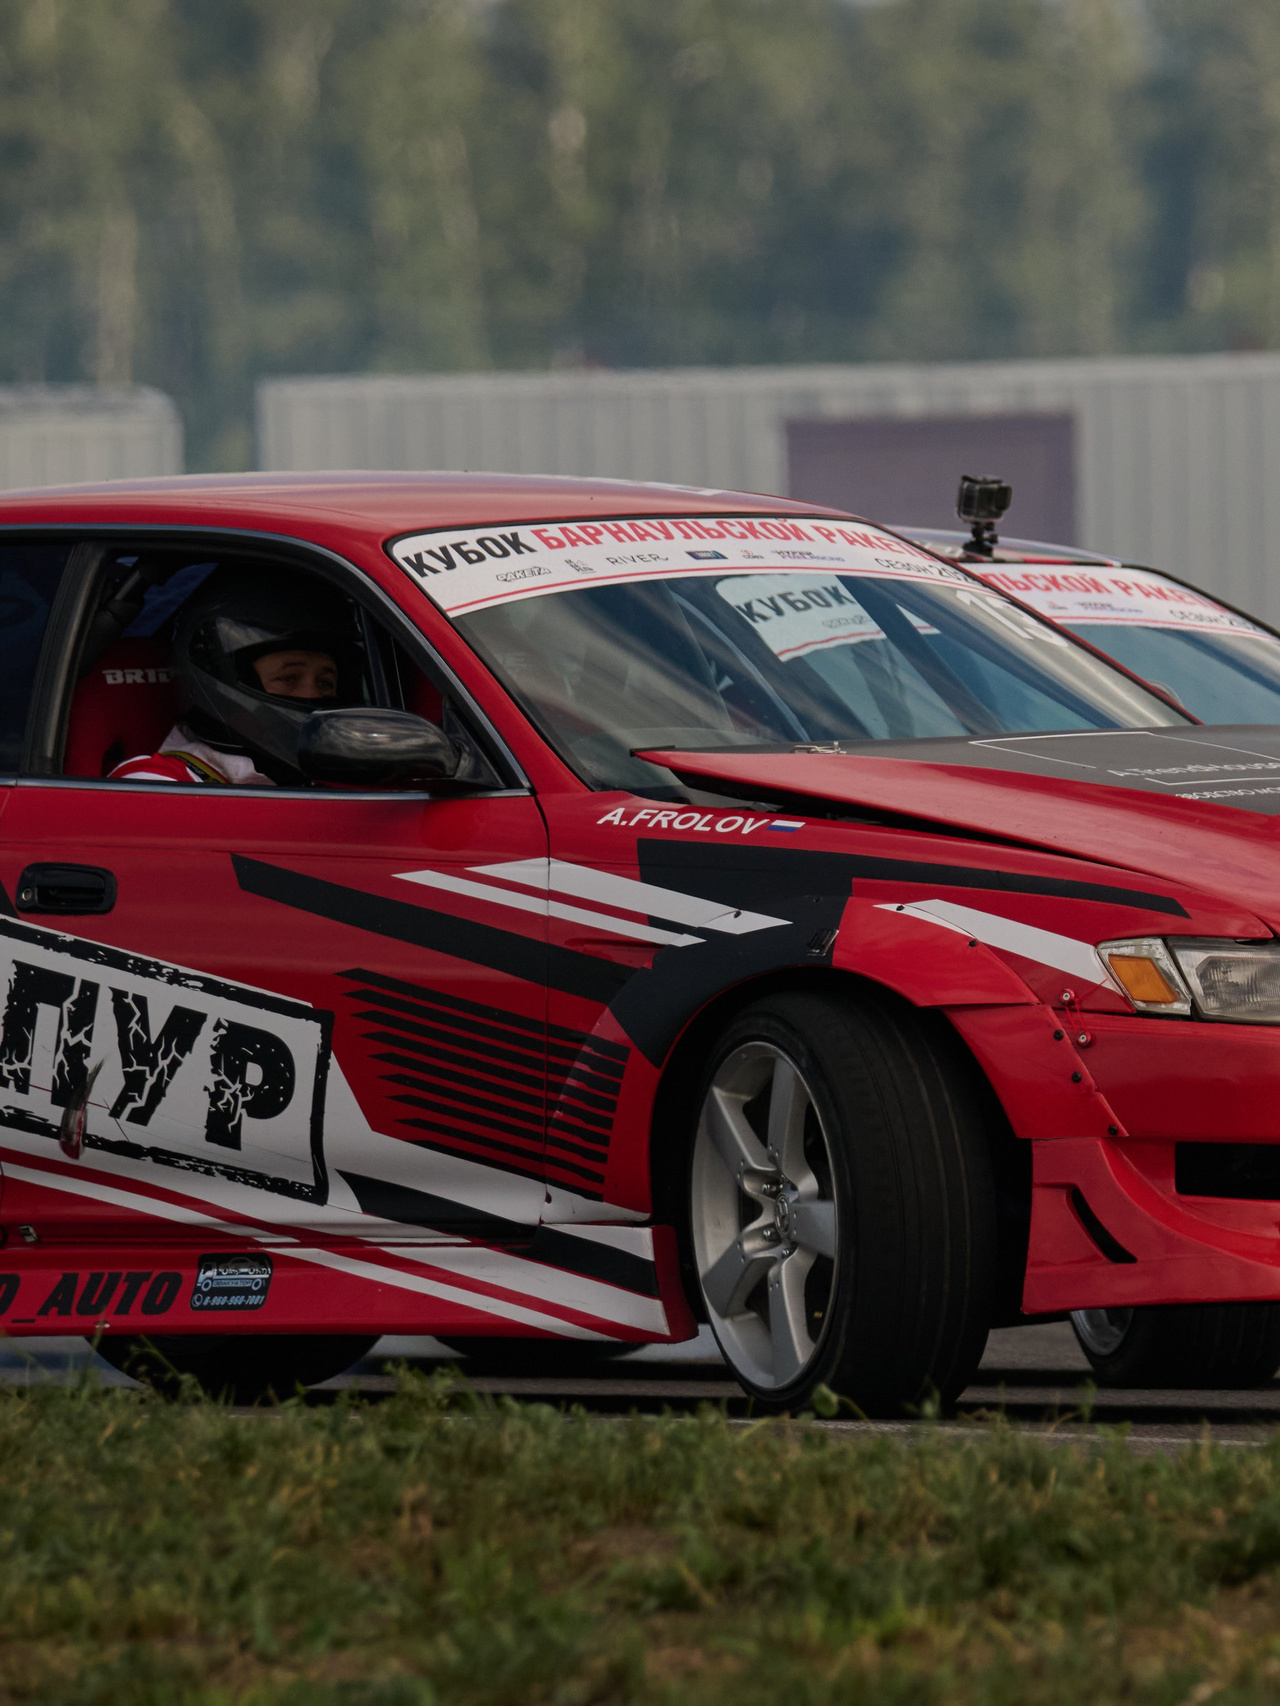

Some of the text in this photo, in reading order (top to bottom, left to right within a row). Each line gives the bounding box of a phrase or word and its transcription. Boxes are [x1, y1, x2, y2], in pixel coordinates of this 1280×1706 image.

[401, 531, 538, 578] КУБОК
[530, 518, 816, 550] БАРНАУЛЬСКОЙ
[874, 557, 932, 576] СЕЗОН
[735, 584, 857, 624] КУБОК
[596, 806, 770, 835] A.FROLOV
